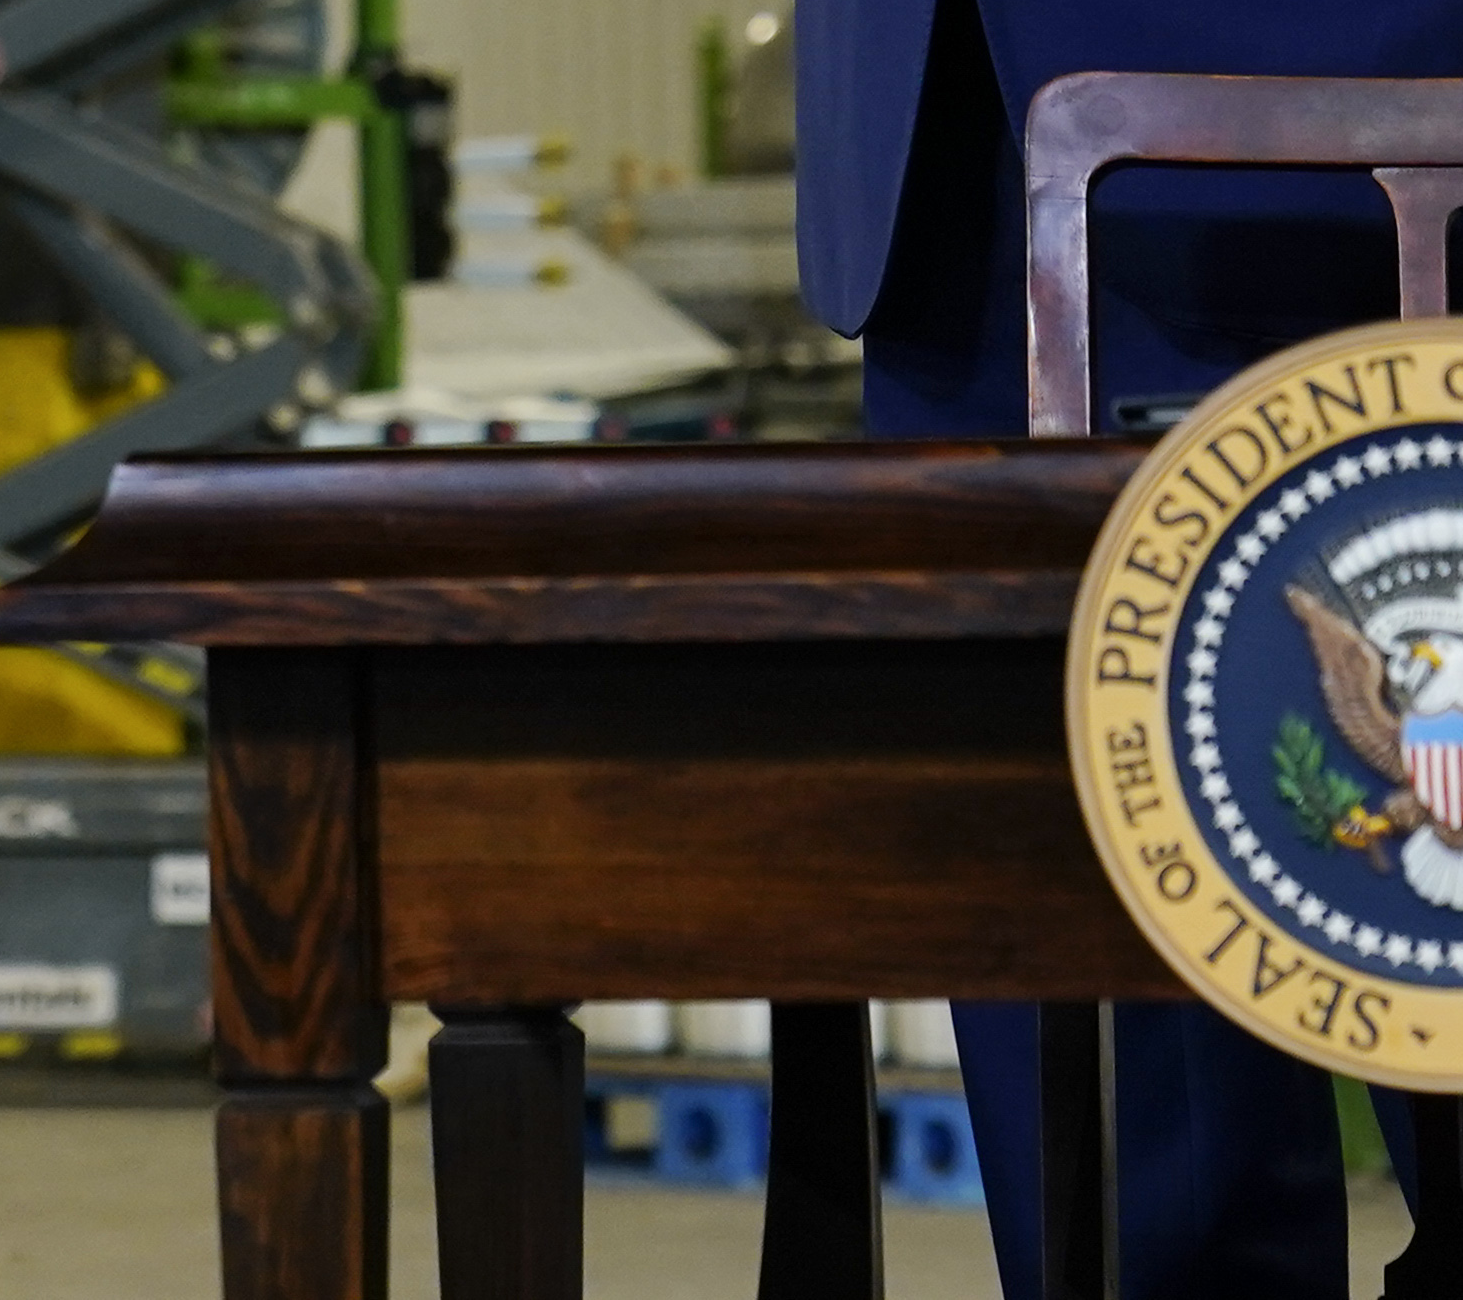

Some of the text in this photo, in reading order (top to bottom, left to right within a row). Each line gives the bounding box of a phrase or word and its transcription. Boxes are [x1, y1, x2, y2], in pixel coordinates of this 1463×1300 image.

[1097, 353, 1417, 691] PRESIDENT
[1107, 721, 1163, 826] THE
[1141, 842, 1198, 902] OF
[1203, 899, 1391, 1050] SEAL
